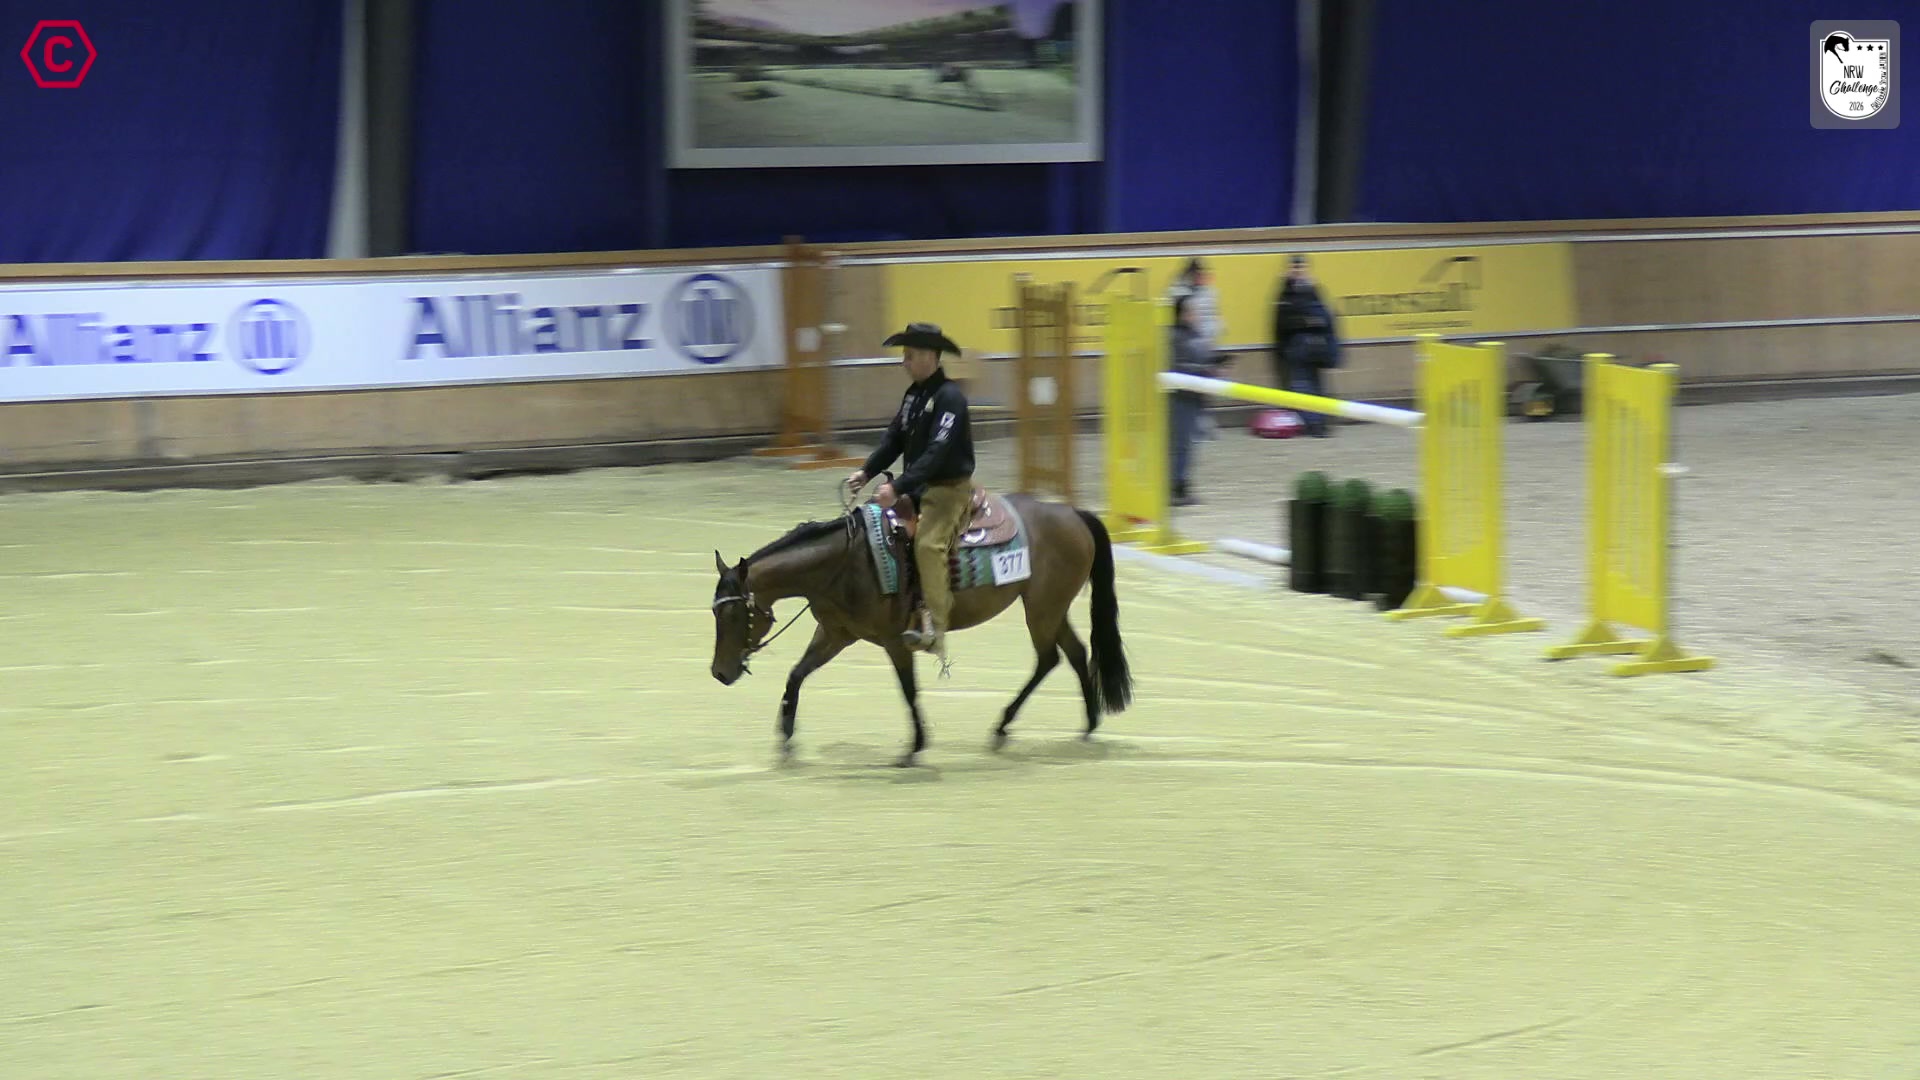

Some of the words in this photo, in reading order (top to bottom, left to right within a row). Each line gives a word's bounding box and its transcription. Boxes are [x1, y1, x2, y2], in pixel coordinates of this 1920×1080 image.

[0, 312, 218, 369] Allianz
[402, 291, 655, 361] Allianz
[999, 551, 1024, 576] 377
